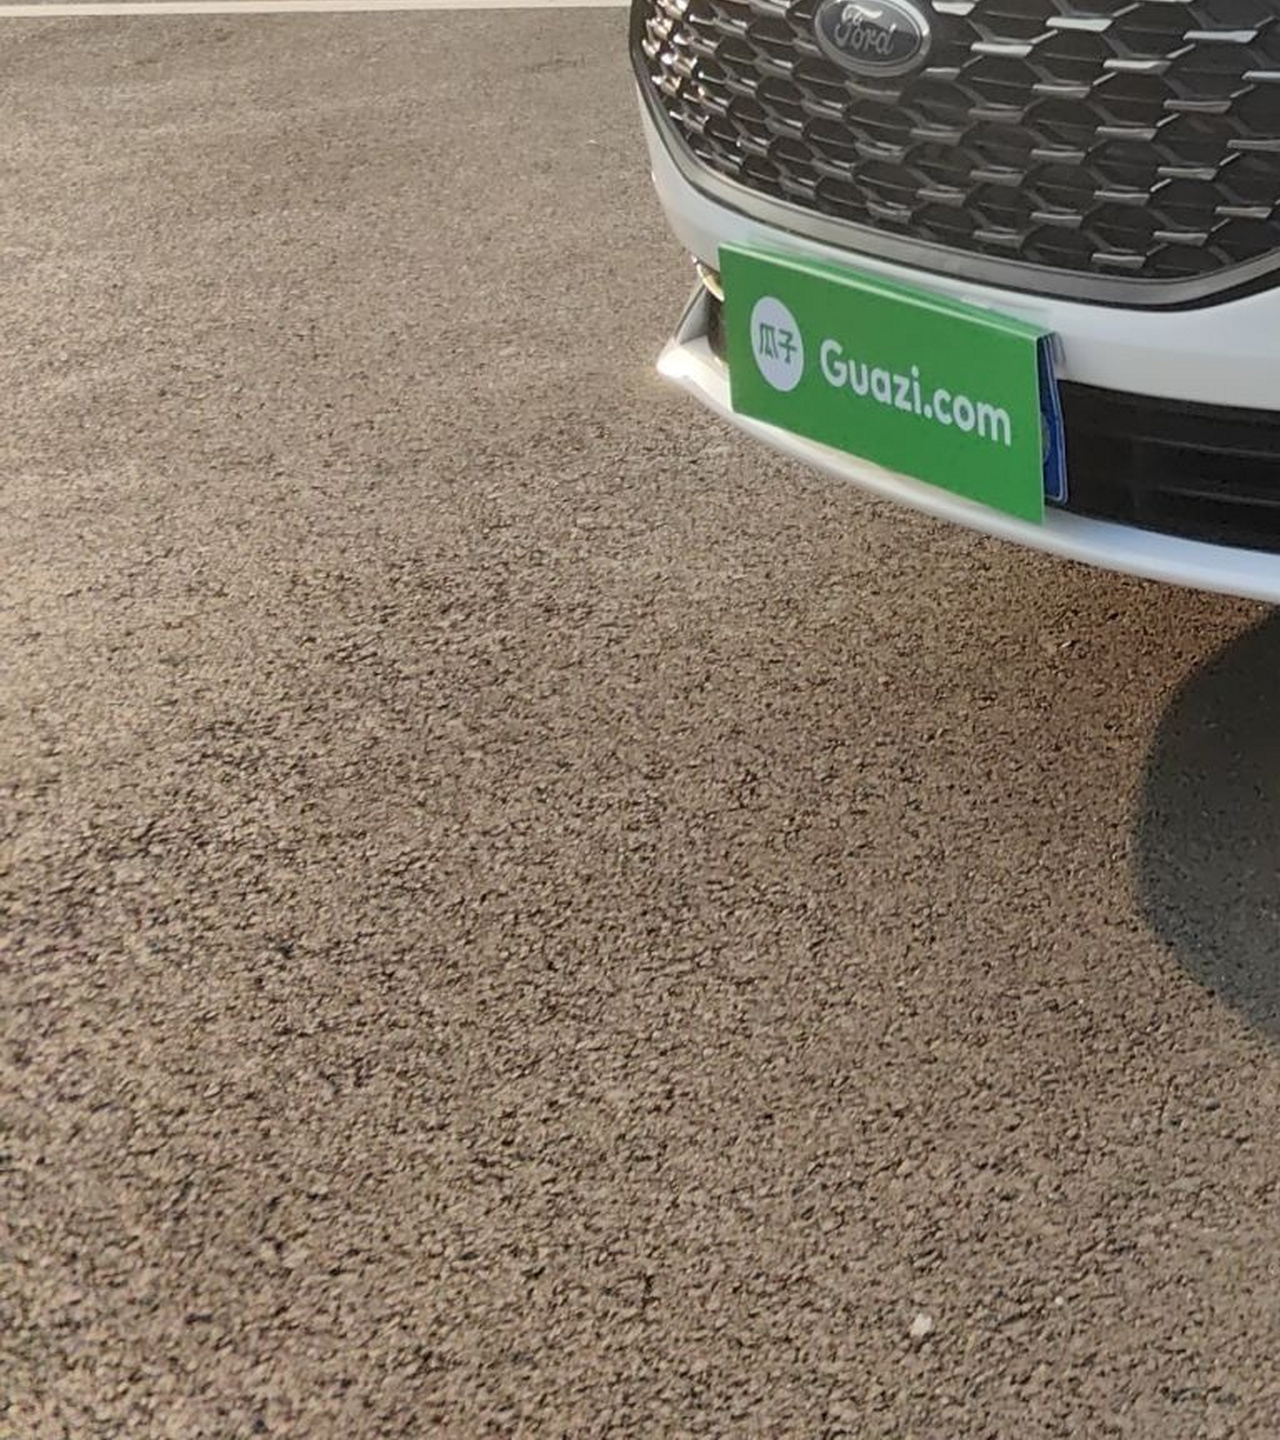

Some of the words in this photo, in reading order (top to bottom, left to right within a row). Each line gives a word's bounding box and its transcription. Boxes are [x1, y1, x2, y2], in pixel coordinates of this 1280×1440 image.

[834, 3, 897, 55] Ford
[758, 322, 797, 365] 瓜子
[819, 338, 1012, 448] Guazi.com
